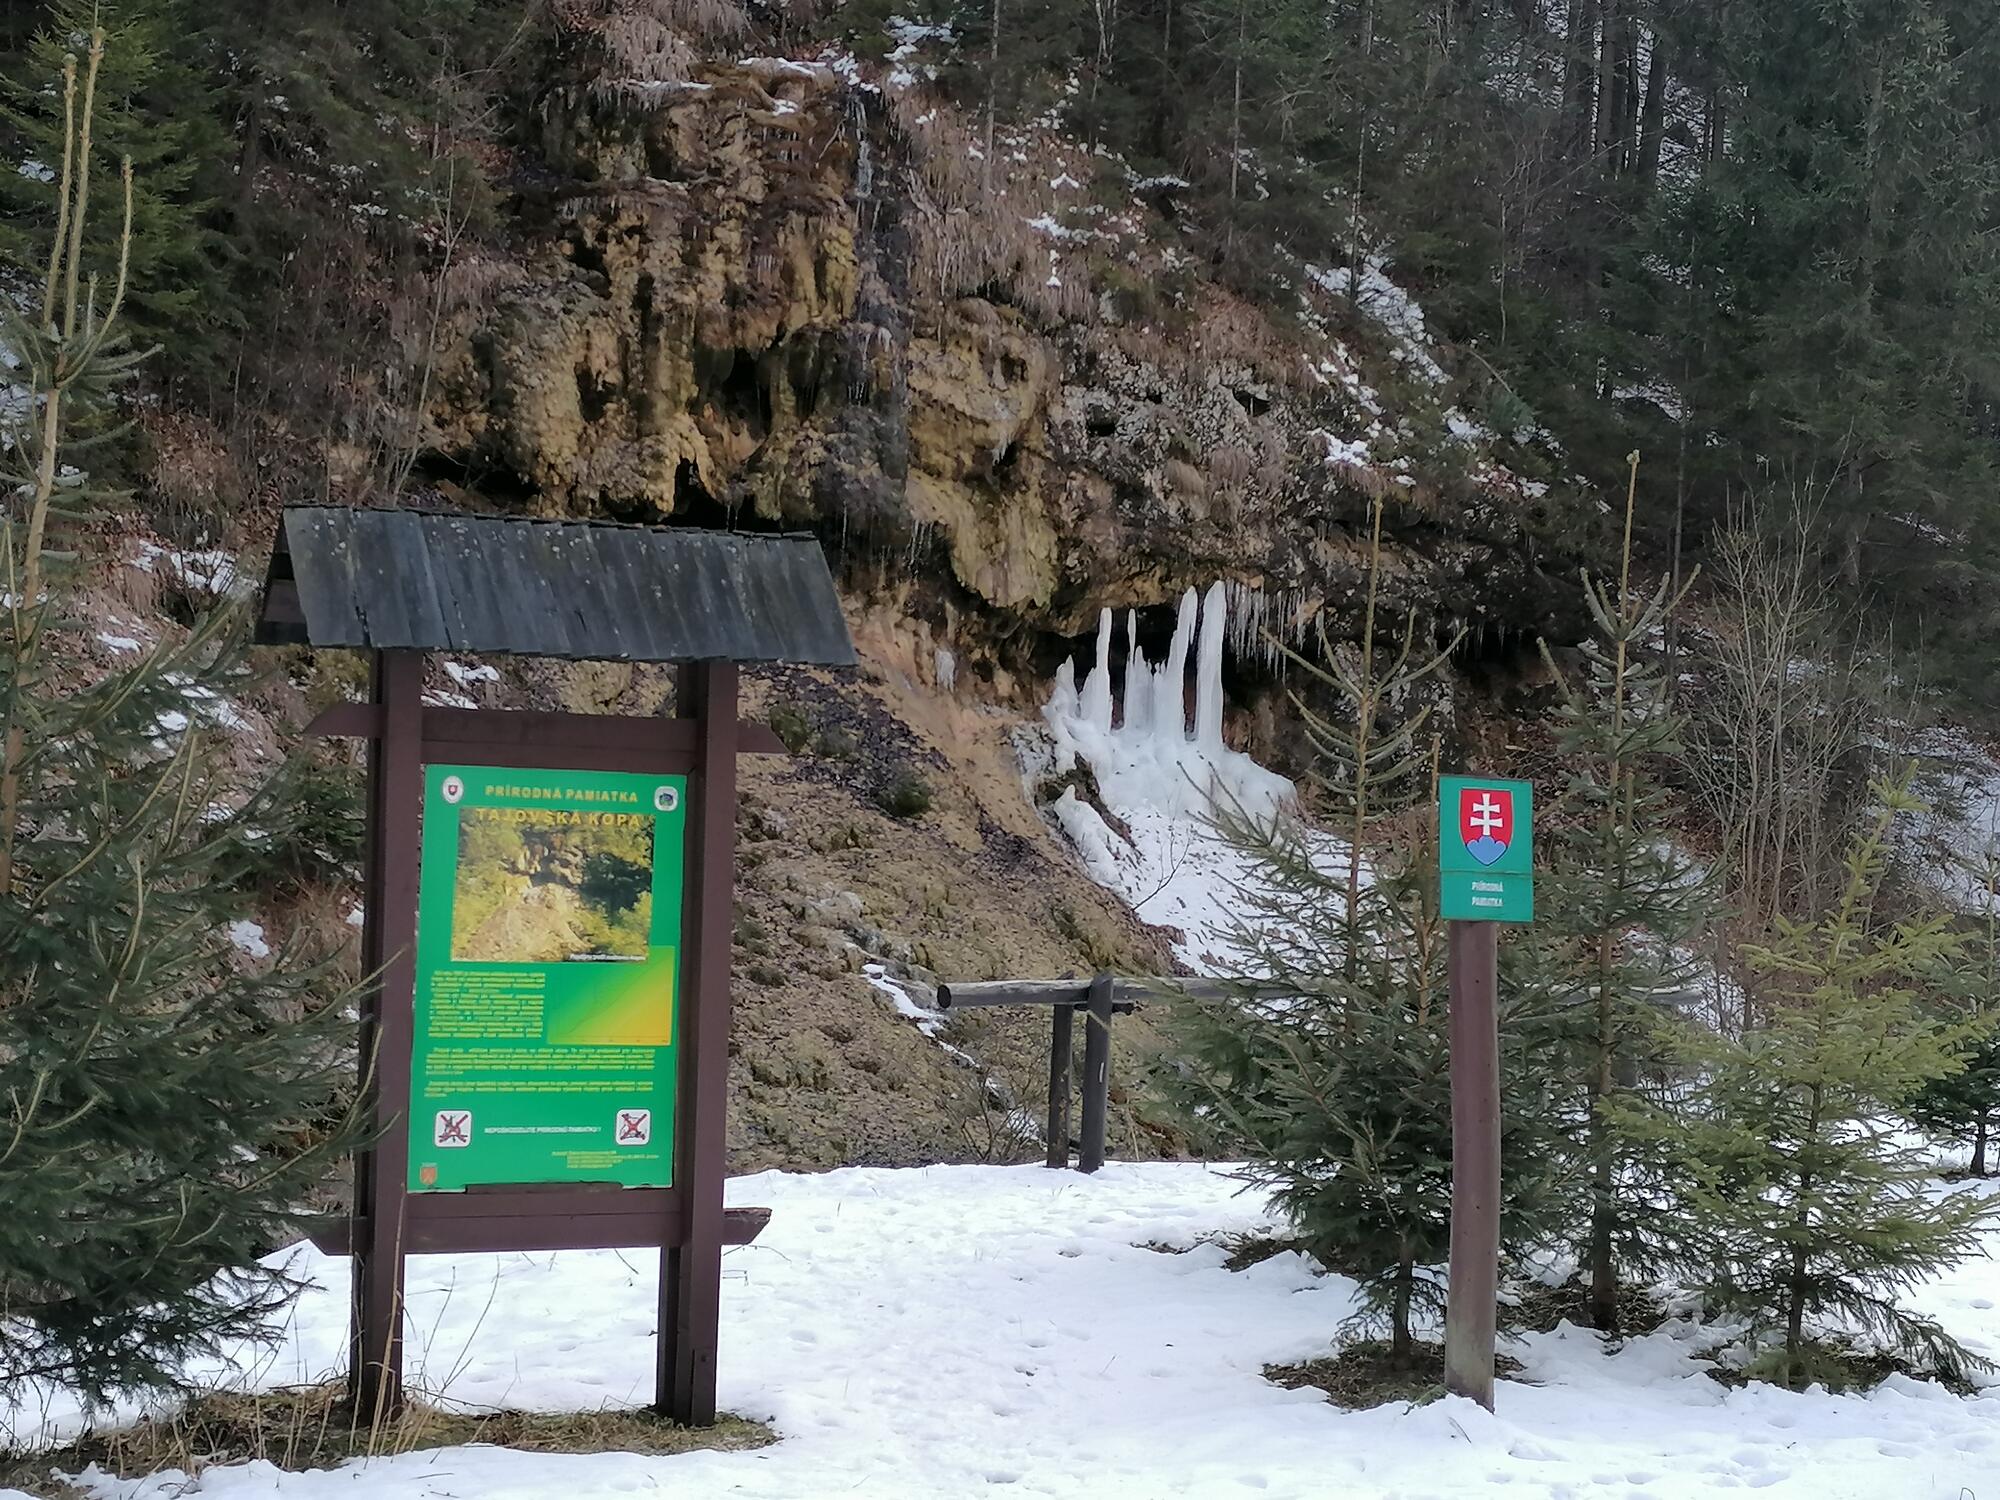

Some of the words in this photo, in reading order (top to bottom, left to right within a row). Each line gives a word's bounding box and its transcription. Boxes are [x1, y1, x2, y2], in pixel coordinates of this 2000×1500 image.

[485, 784, 562, 798] PRÍRODNÁ
[566, 788, 637, 802] PAMIATKA
[589, 813, 640, 827] KOPA
